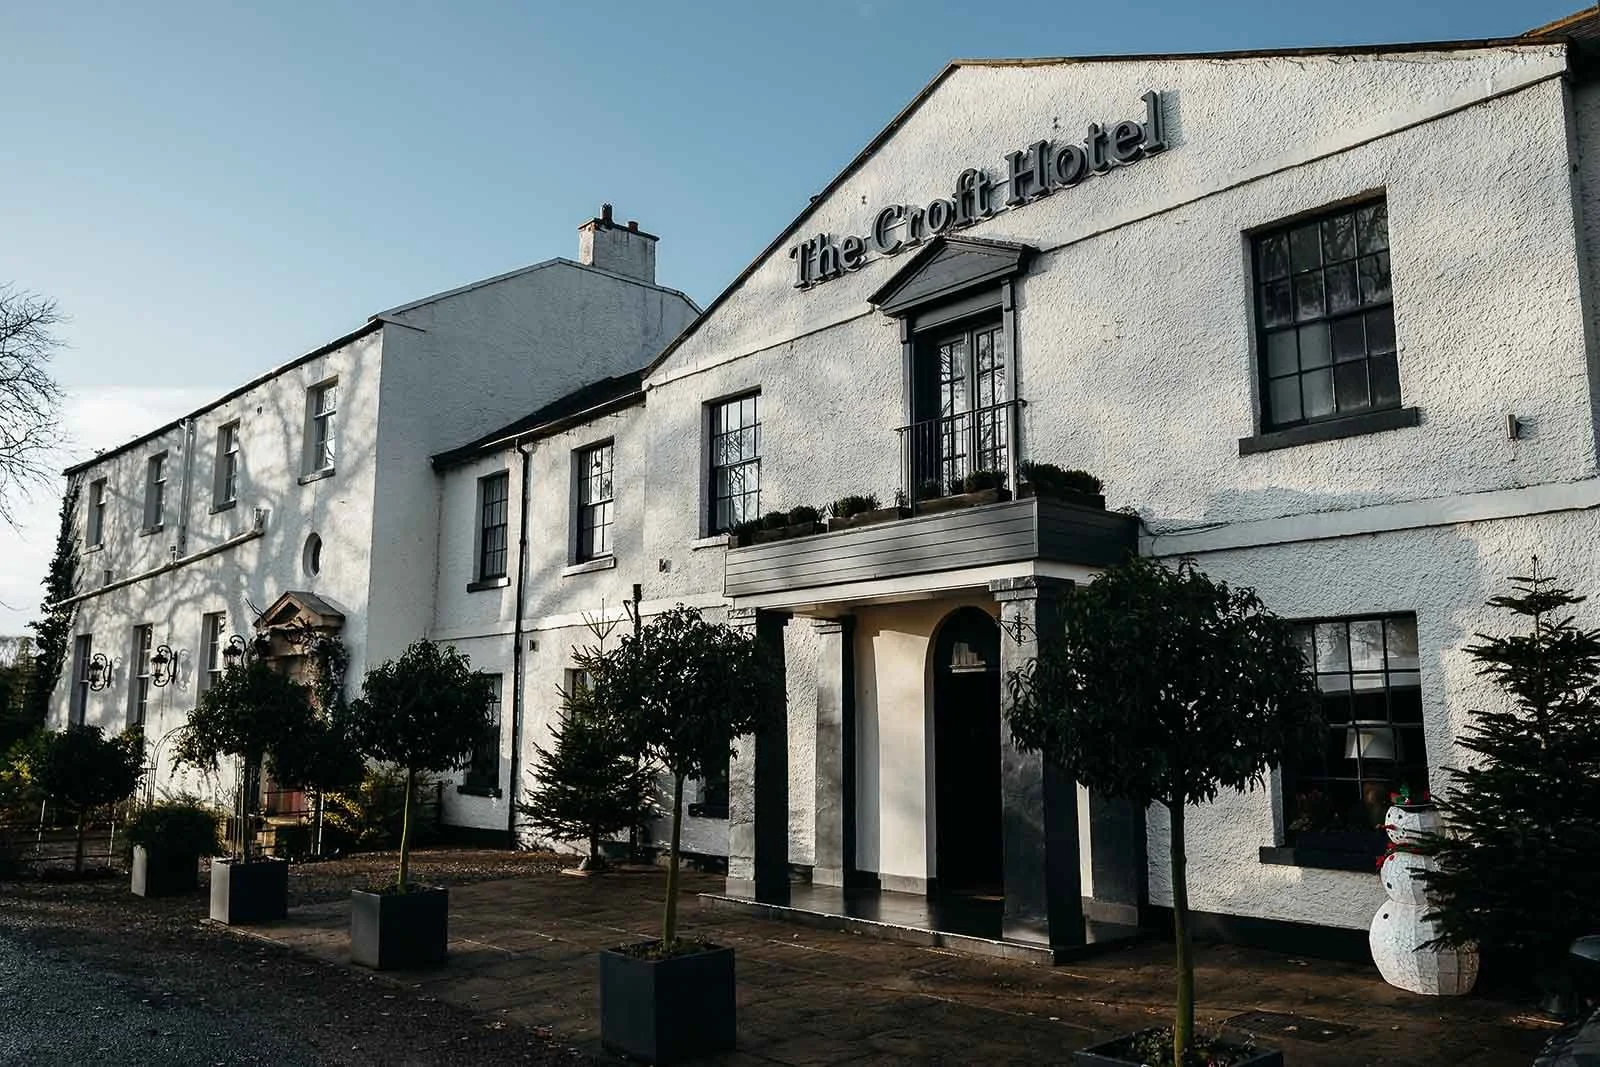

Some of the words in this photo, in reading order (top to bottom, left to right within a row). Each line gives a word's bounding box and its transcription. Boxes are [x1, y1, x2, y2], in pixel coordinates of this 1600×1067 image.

[789, 233, 866, 288] The
[870, 167, 993, 255] Croft
[1004, 89, 1167, 205] Hotel
